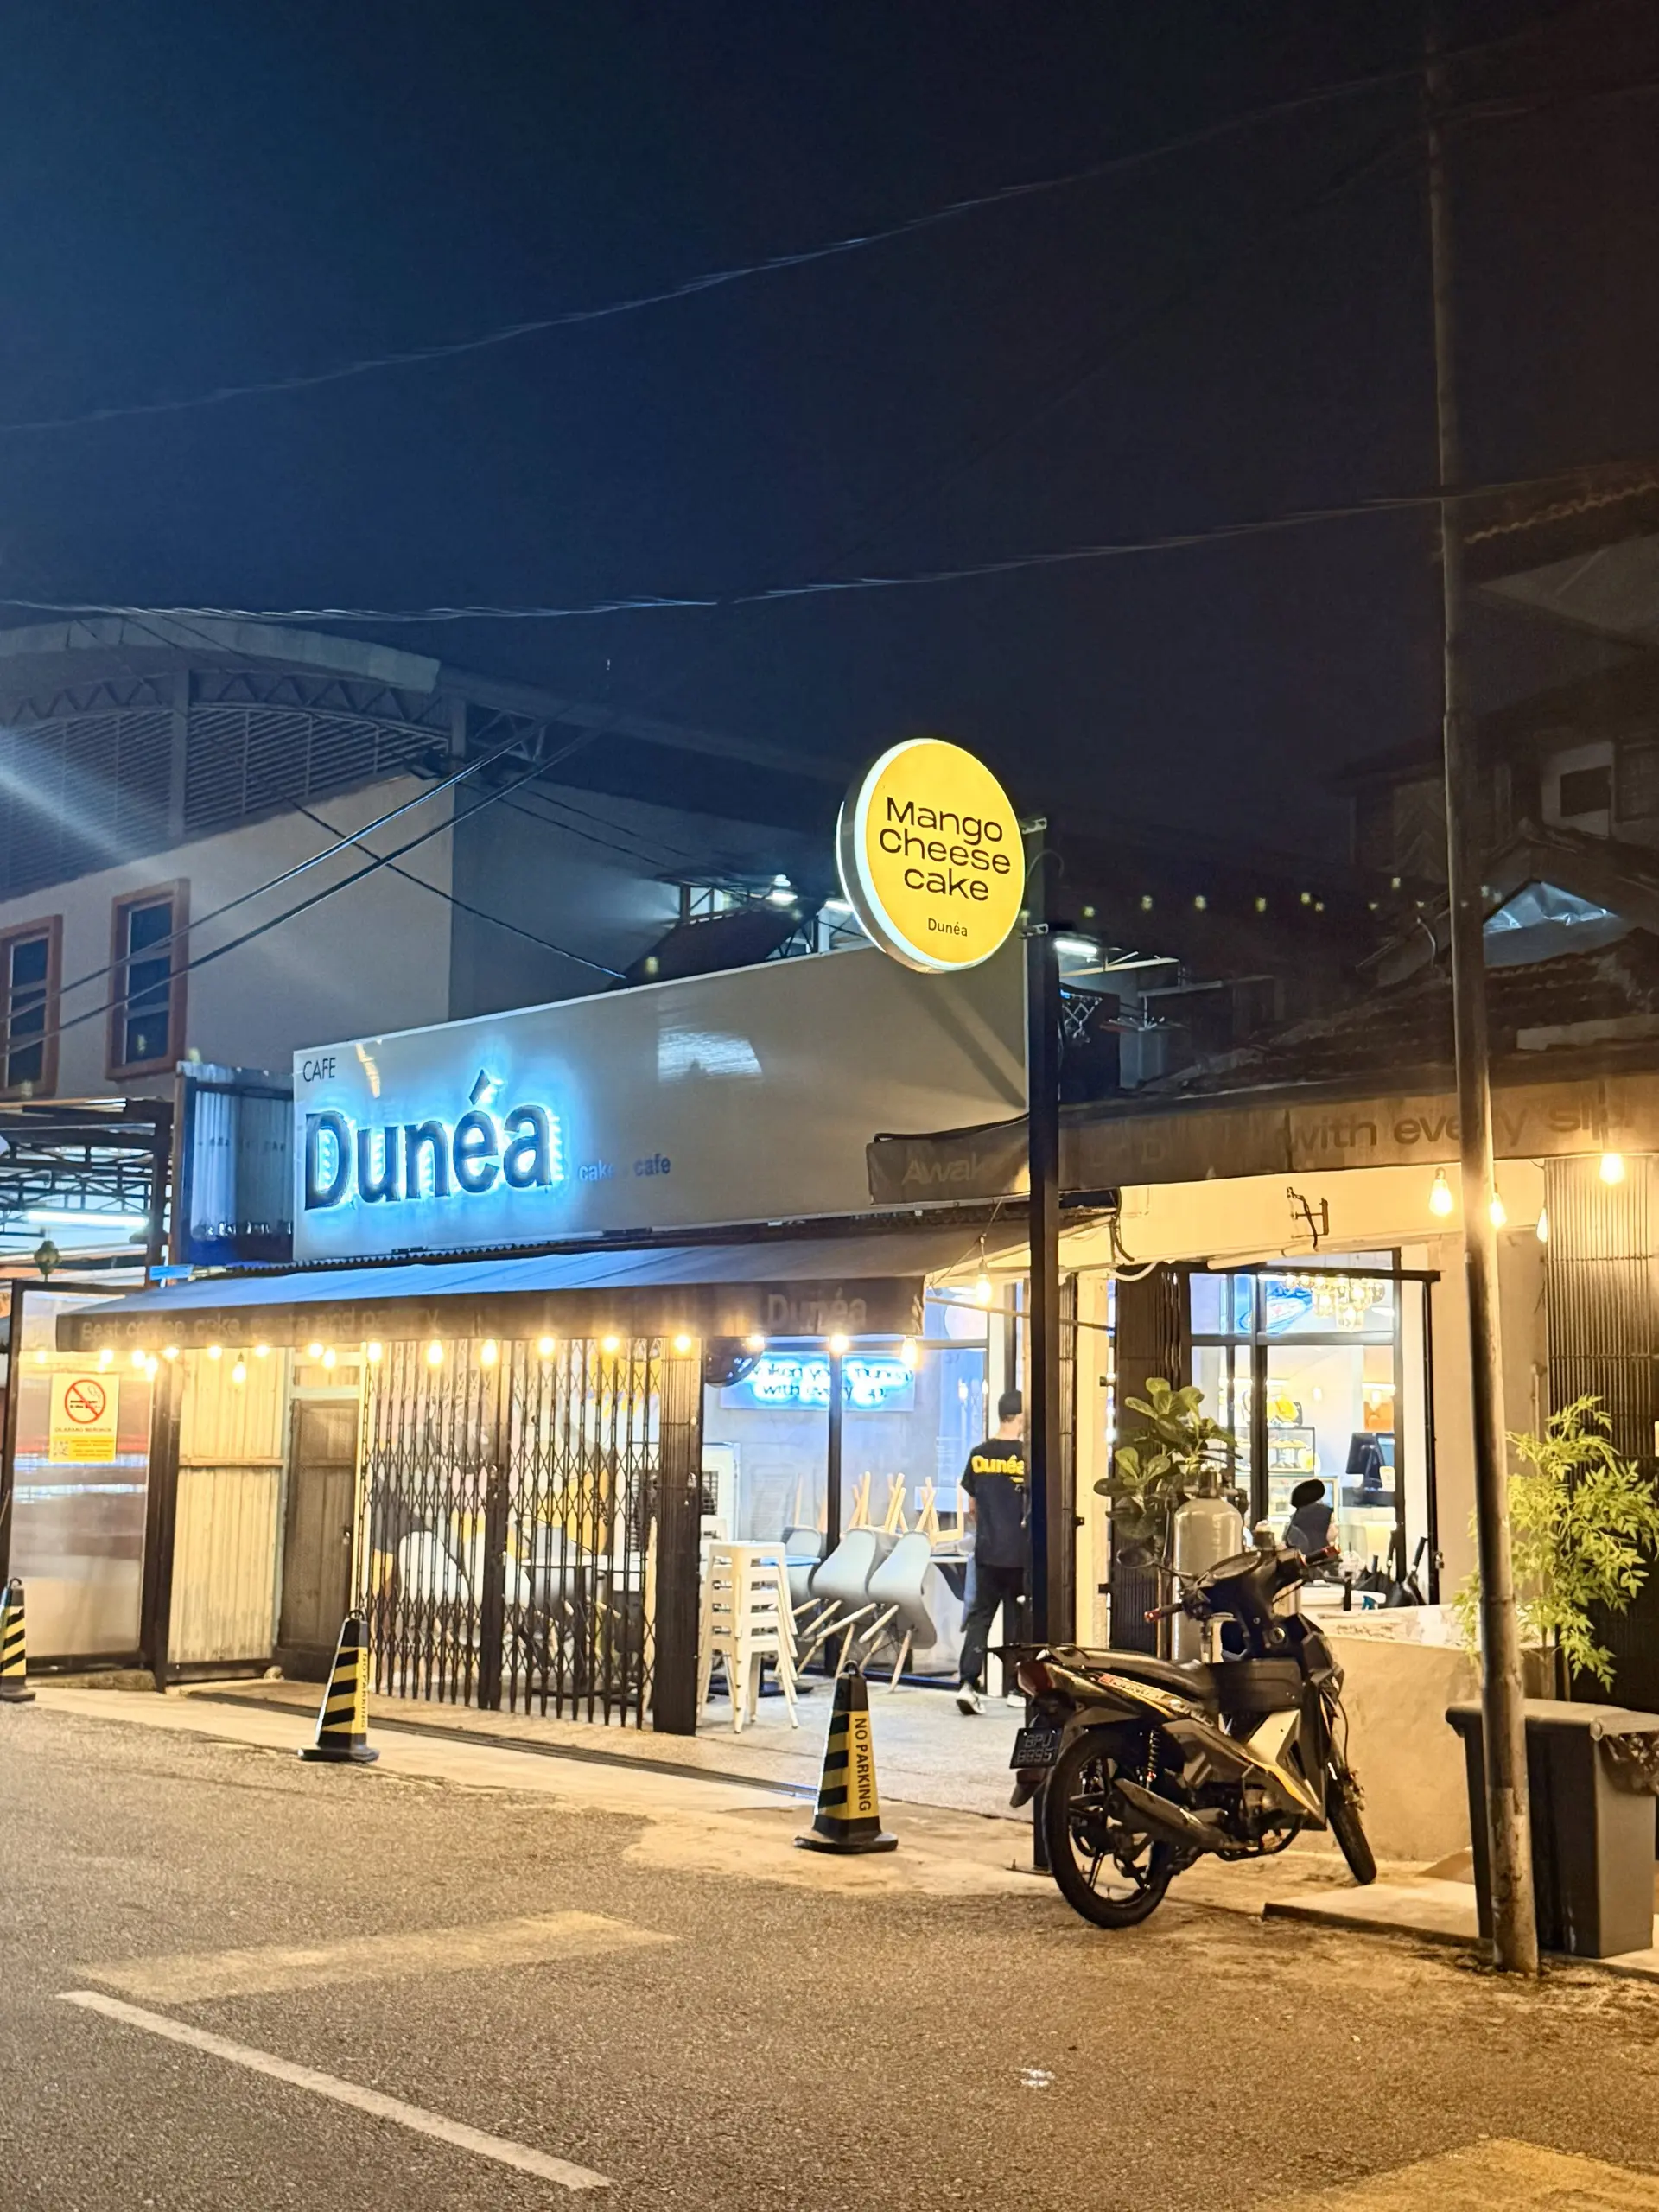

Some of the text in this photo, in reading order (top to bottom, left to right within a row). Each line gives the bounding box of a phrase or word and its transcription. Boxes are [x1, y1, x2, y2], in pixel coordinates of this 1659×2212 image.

[887, 797, 1003, 846] Mango
[880, 828, 1011, 874] Cheese
[904, 868, 989, 901] cake
[928, 918, 968, 937] Dunéa
[303, 1057, 336, 1082] CAFE
[305, 1069, 553, 1211] Dunéa
[902, 1152, 986, 1185] Awak
[1394, 1108, 1528, 1147] evey
[633, 1153, 671, 1176] cafe
[855, 1717, 872, 1812] NO PARKING
